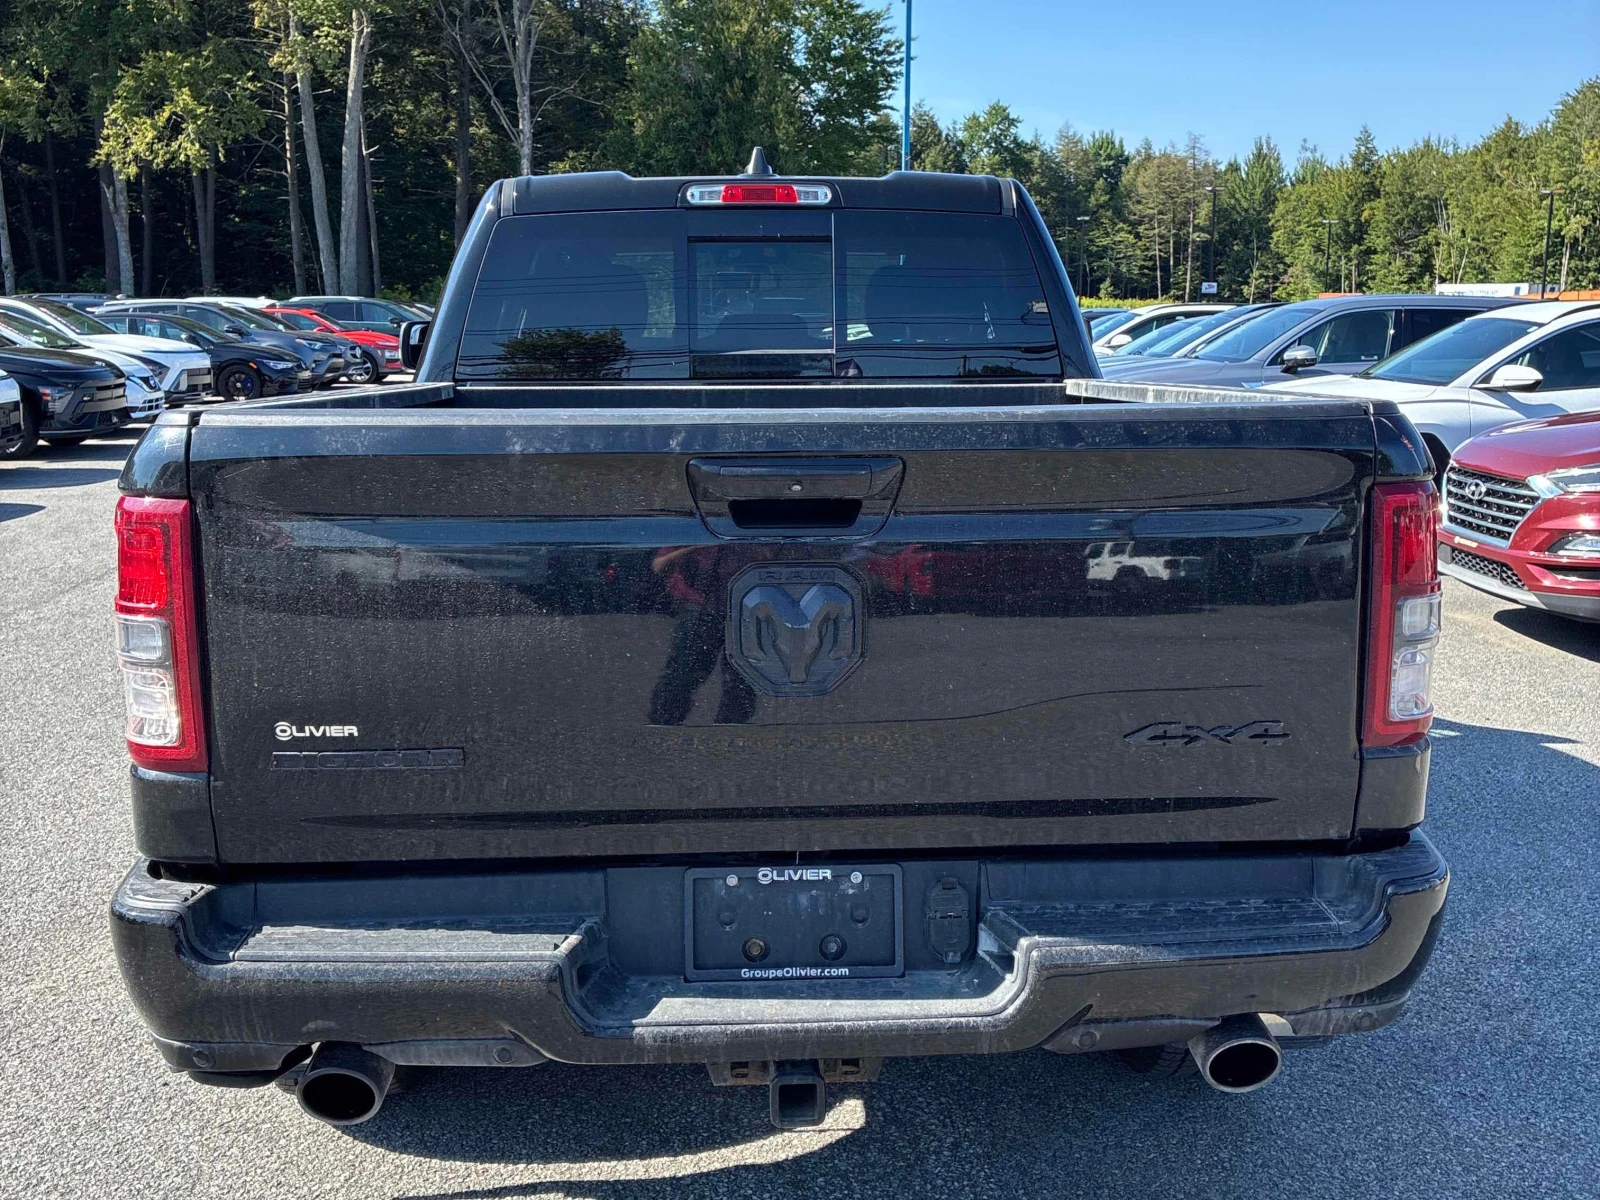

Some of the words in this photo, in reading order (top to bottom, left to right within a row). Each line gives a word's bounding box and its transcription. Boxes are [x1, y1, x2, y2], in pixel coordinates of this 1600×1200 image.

[274, 721, 359, 741] OLIVIER
[757, 867, 832, 885] OLIVIER
[740, 966, 849, 979] GroupeOlivier.com
